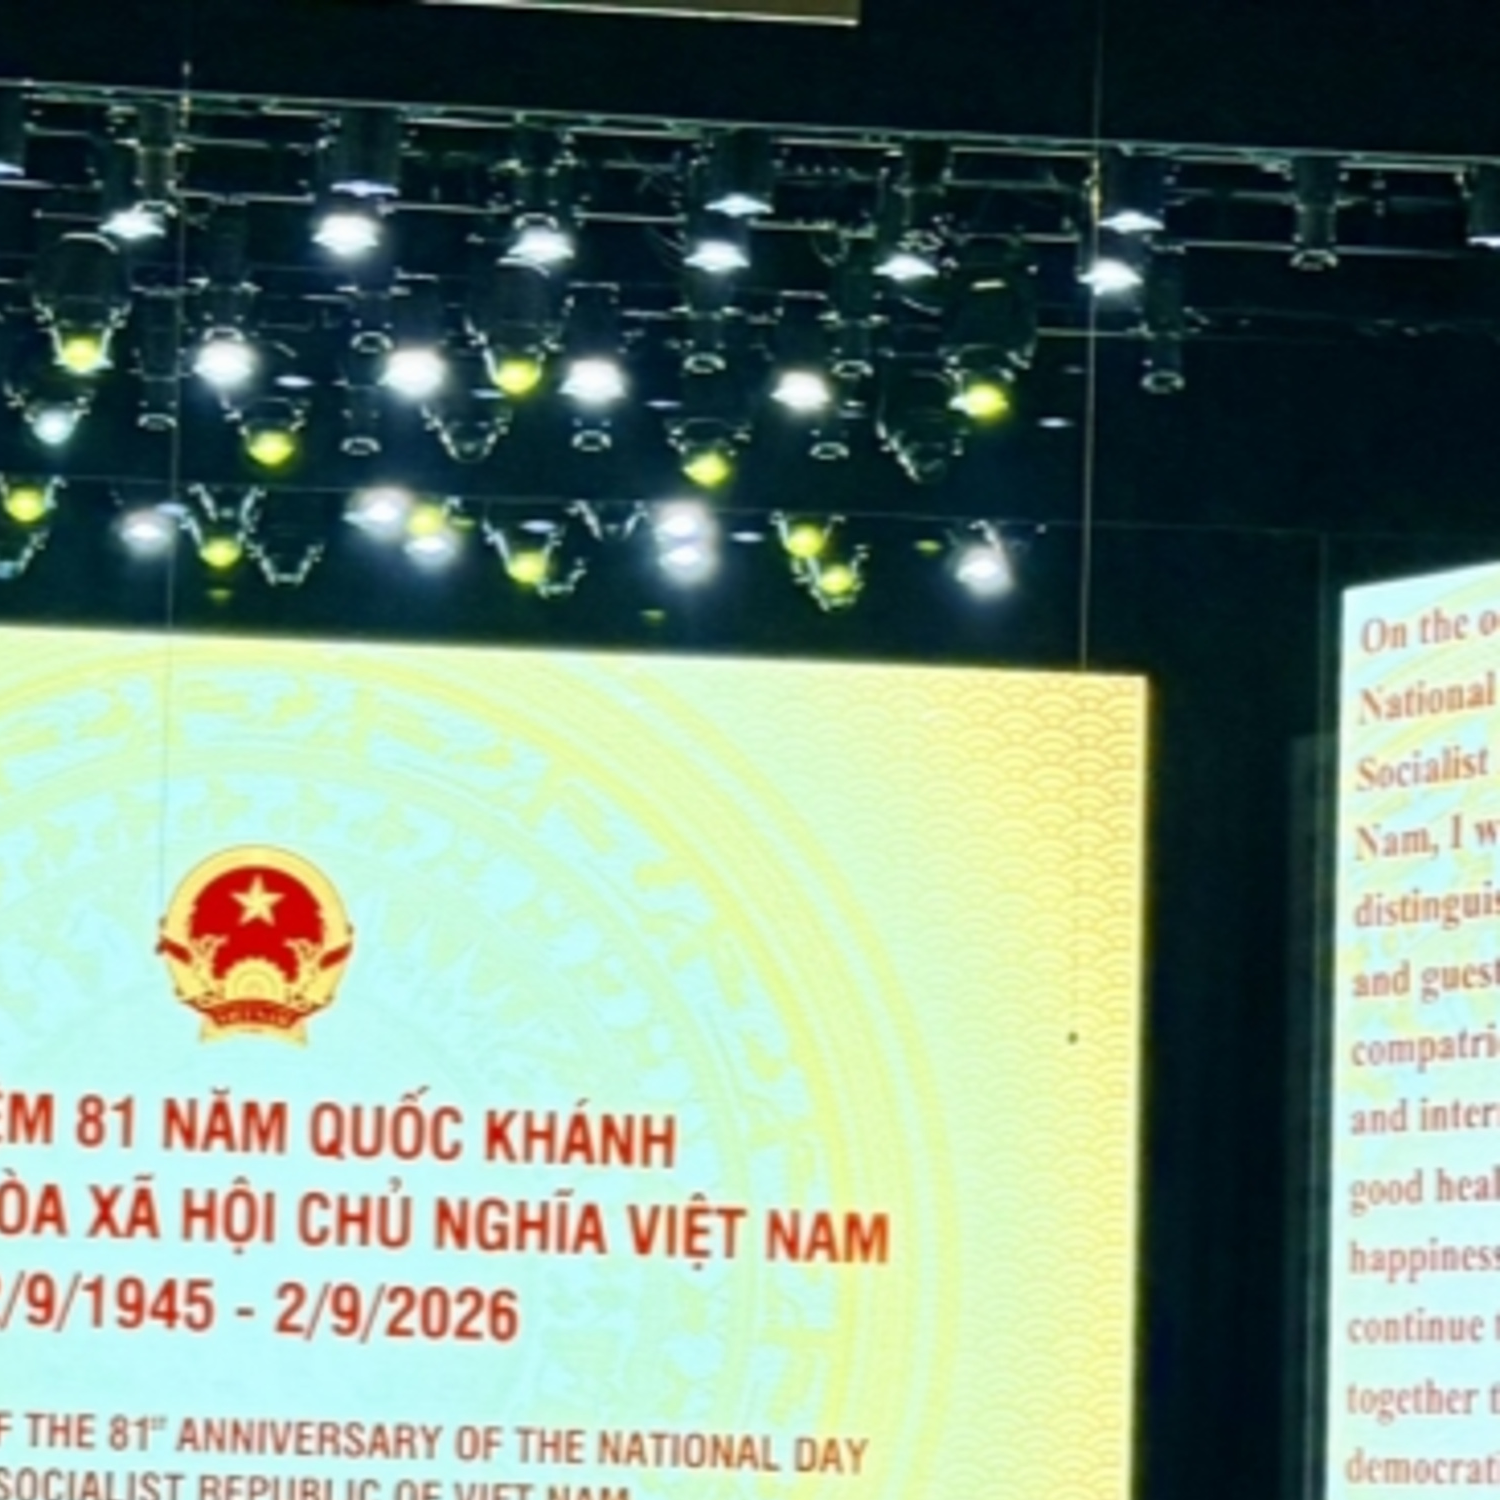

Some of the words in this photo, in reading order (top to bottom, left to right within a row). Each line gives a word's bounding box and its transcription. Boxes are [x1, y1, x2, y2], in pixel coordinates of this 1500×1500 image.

[1361, 617, 1406, 653] On
[1420, 607, 1468, 644] the
[1358, 671, 1495, 725] National
[1356, 745, 1488, 791] Socialist
[1355, 824, 1440, 861] Nam,
[1353, 959, 1410, 998] and
[1351, 1022, 1500, 1074] compatri
[76, 1094, 135, 1149] 81
[161, 1088, 288, 1154] NĂM
[309, 1086, 464, 1161] QUỐC
[485, 1097, 676, 1169] KHÁNH
[1351, 1097, 1407, 1136] and
[1419, 1096, 1500, 1132] inter
[1350, 1167, 1423, 1217] good
[86, 1173, 161, 1240] XÃ
[182, 1176, 276, 1255] HỘI
[298, 1176, 412, 1250] CHỦ
[434, 1187, 609, 1256] NGHĨA
[626, 1192, 748, 1271] VIỆT
[766, 1208, 889, 1264] NAM
[274, 1281, 519, 1344] 2/9/2026
[1348, 1306, 1485, 1344] continue
[1347, 1378, 1479, 1426] together
[25, 1412, 95, 1451] THE
[176, 1416, 443, 1462] ANNIVERSARY
[454, 1424, 502, 1462] OF
[515, 1427, 586, 1465] THE
[597, 1429, 781, 1473] NATIONAL
[794, 1437, 870, 1475] DAY
